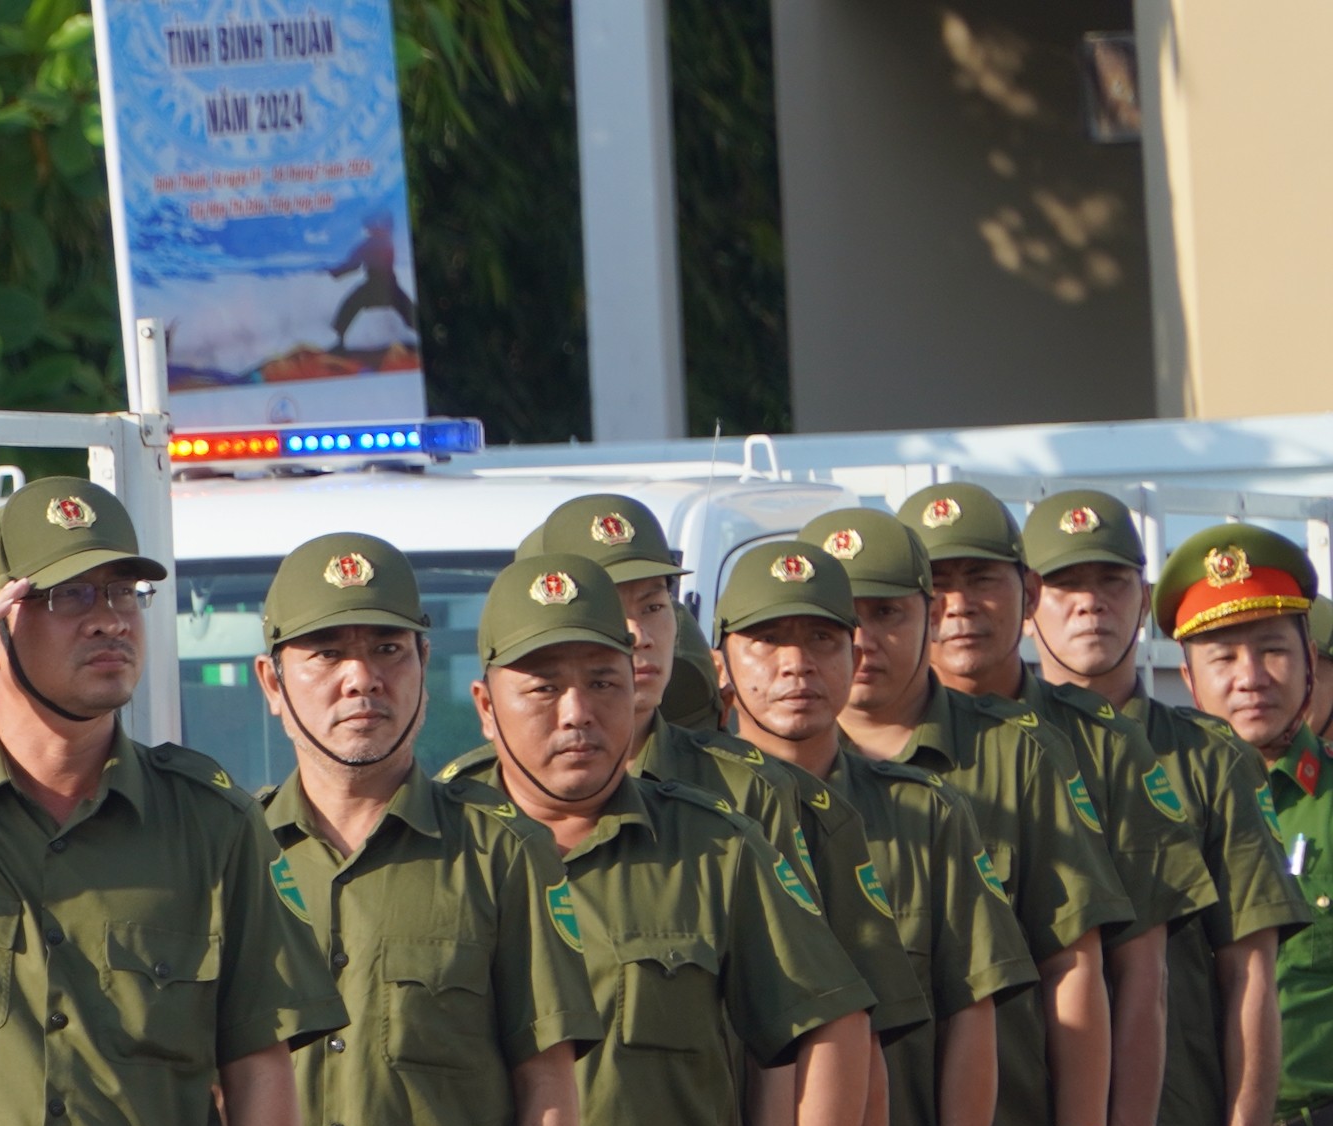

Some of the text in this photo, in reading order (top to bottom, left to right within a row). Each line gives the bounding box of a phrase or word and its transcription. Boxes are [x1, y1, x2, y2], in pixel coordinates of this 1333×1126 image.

[216, 12, 264, 64] BÌNH
[270, 8, 334, 66] THUẬN
[255, 90, 304, 131] 2024
